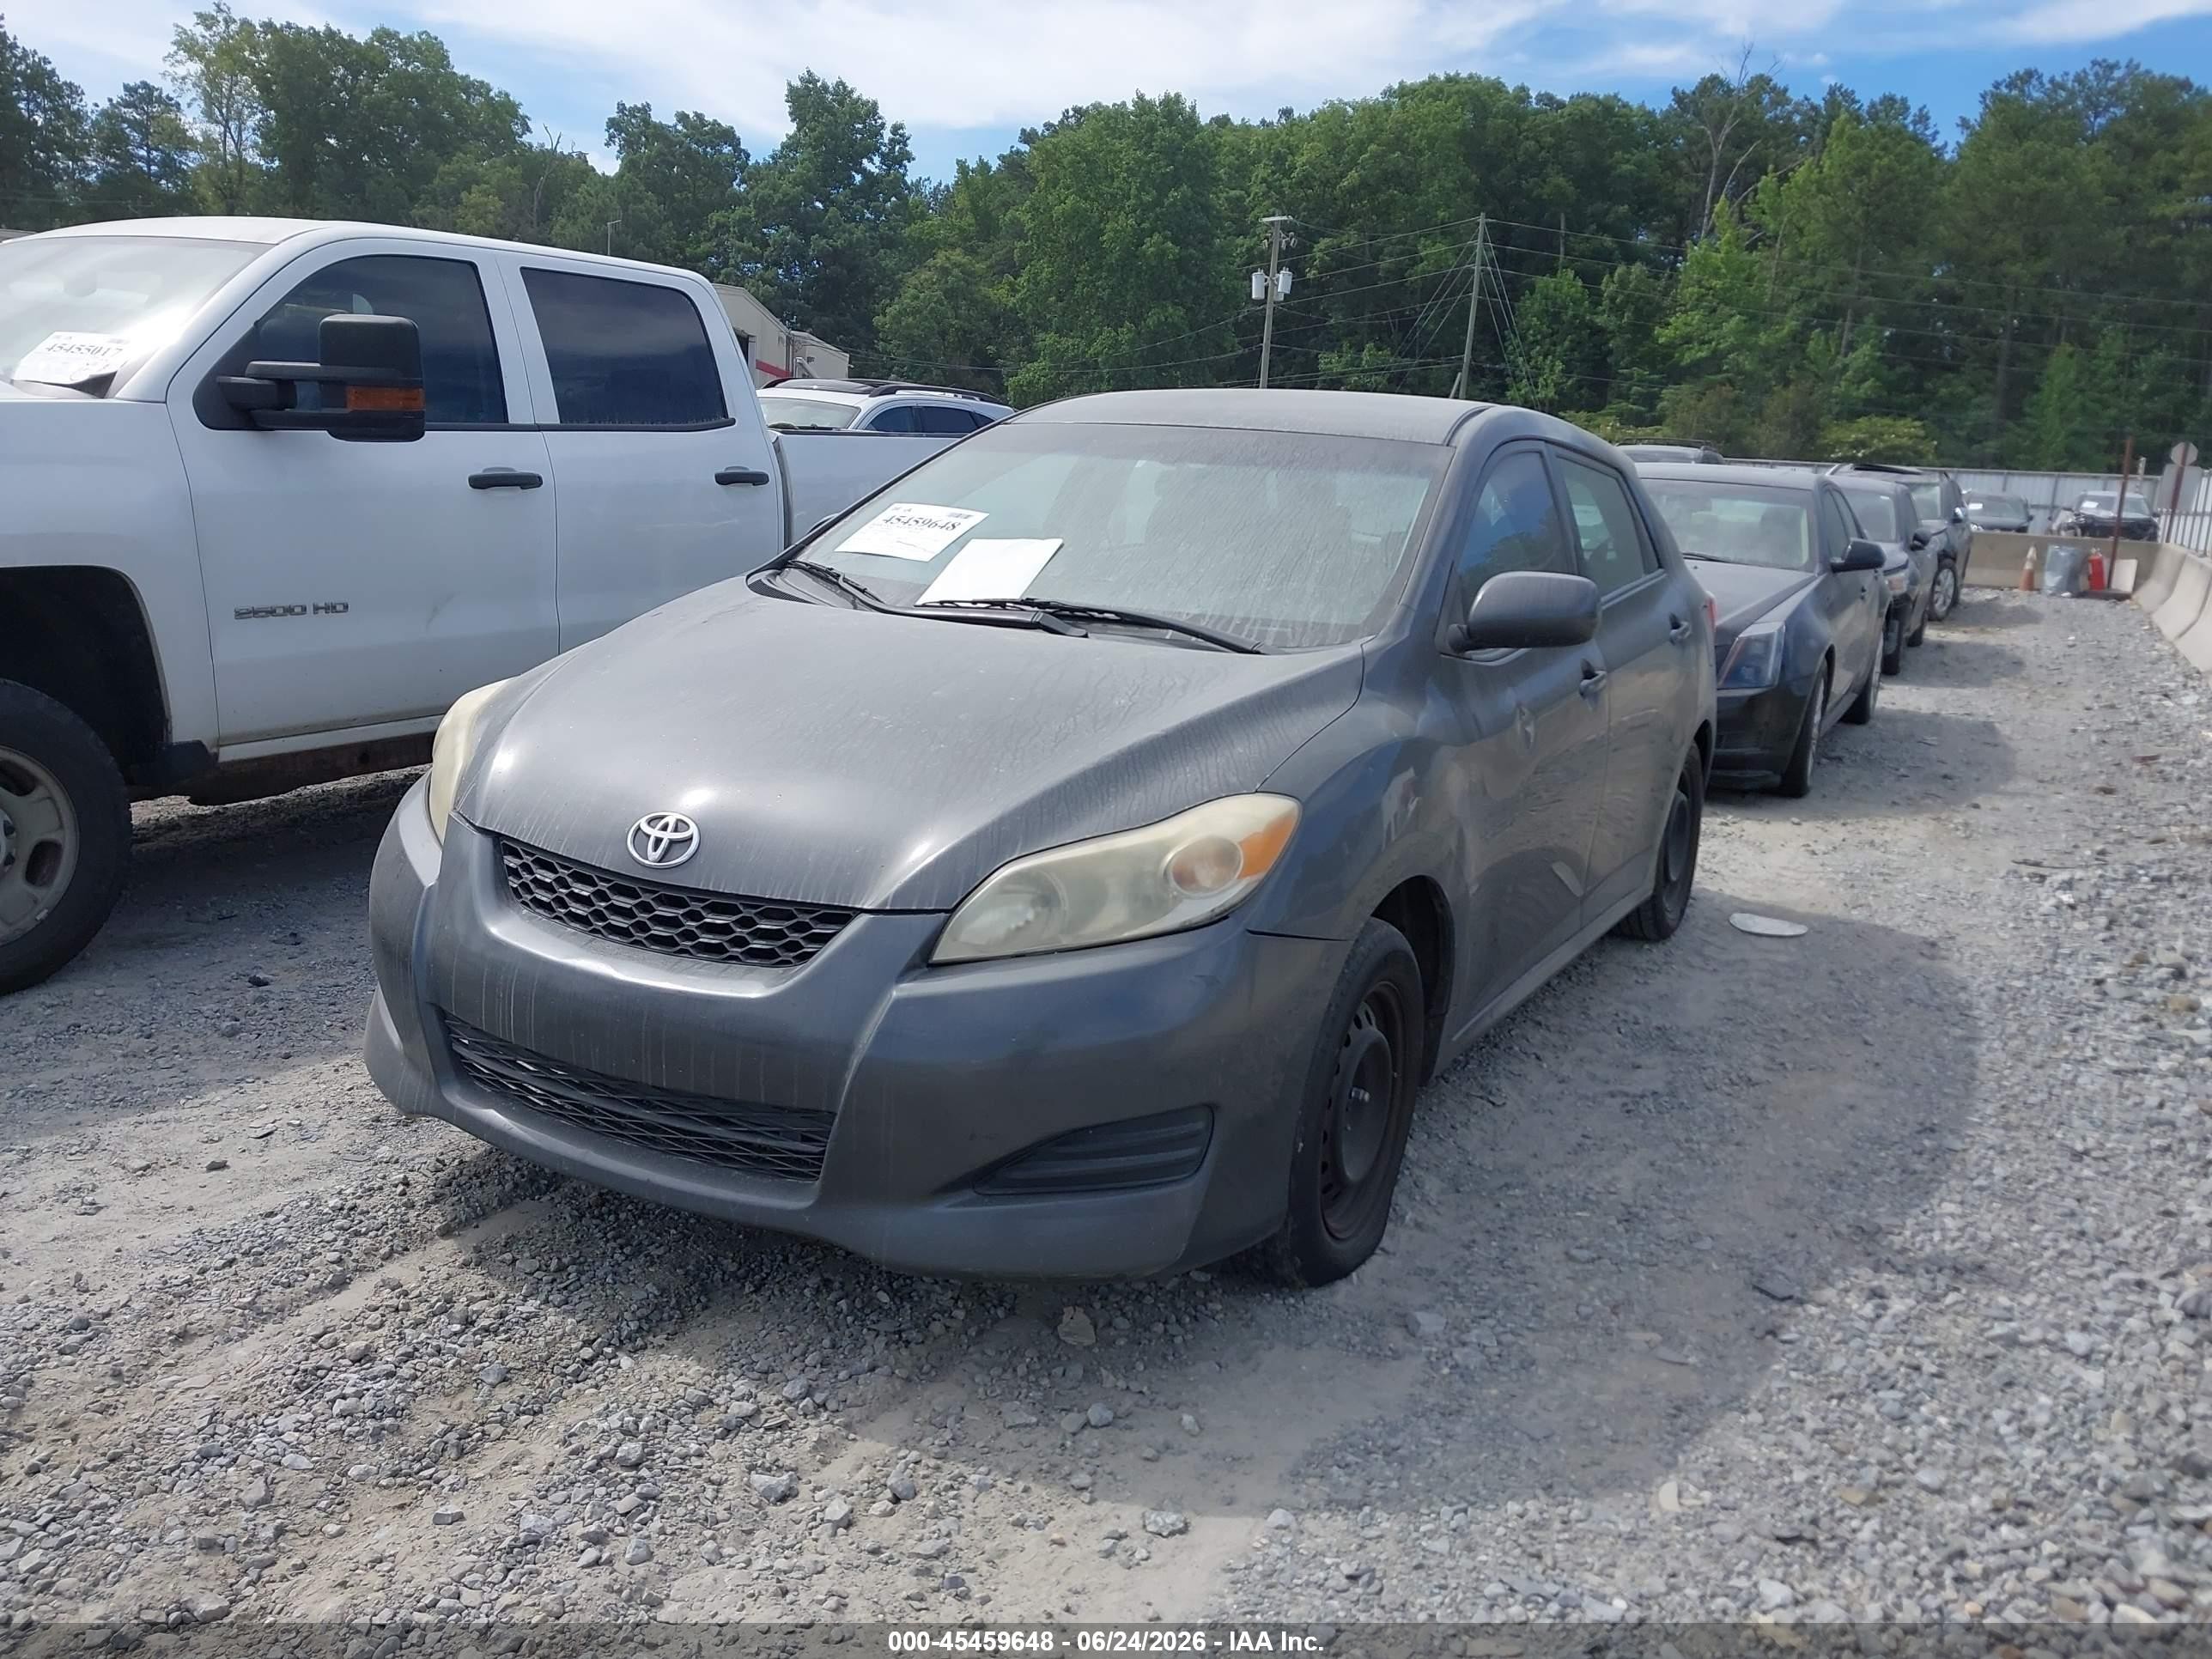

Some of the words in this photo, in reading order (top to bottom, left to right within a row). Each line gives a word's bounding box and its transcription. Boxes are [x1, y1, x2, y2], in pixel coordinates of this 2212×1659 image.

[883, 515, 961, 531] 45459648
[234, 605, 307, 619] 2500
[313, 602, 349, 615] HD
